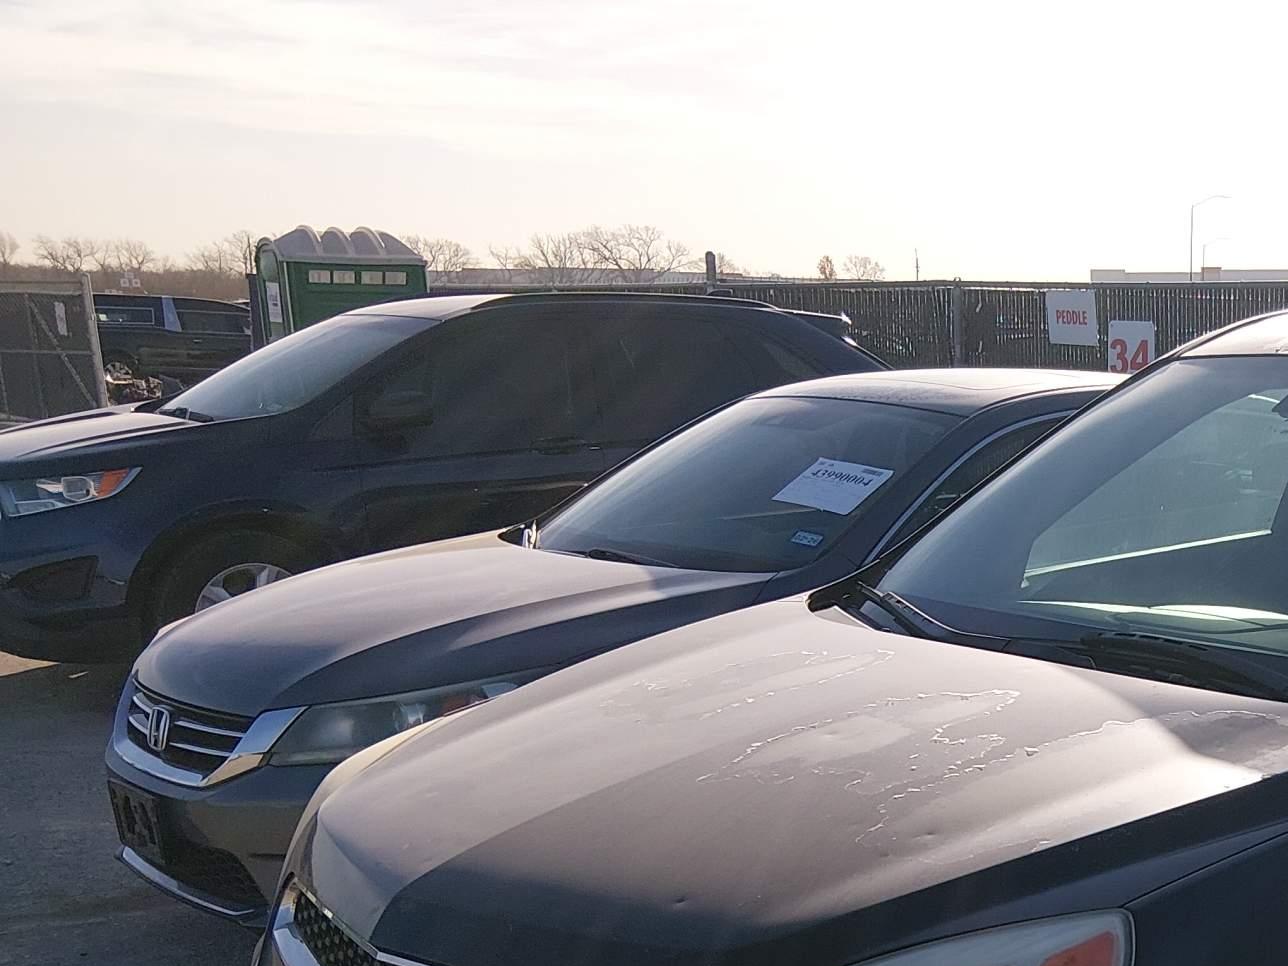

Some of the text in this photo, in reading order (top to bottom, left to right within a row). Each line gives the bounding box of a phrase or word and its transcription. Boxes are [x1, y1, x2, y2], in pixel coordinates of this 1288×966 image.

[1055, 309, 1088, 326] PEDDLE
[1110, 338, 1149, 374] 34
[811, 468, 874, 487] 43990004
